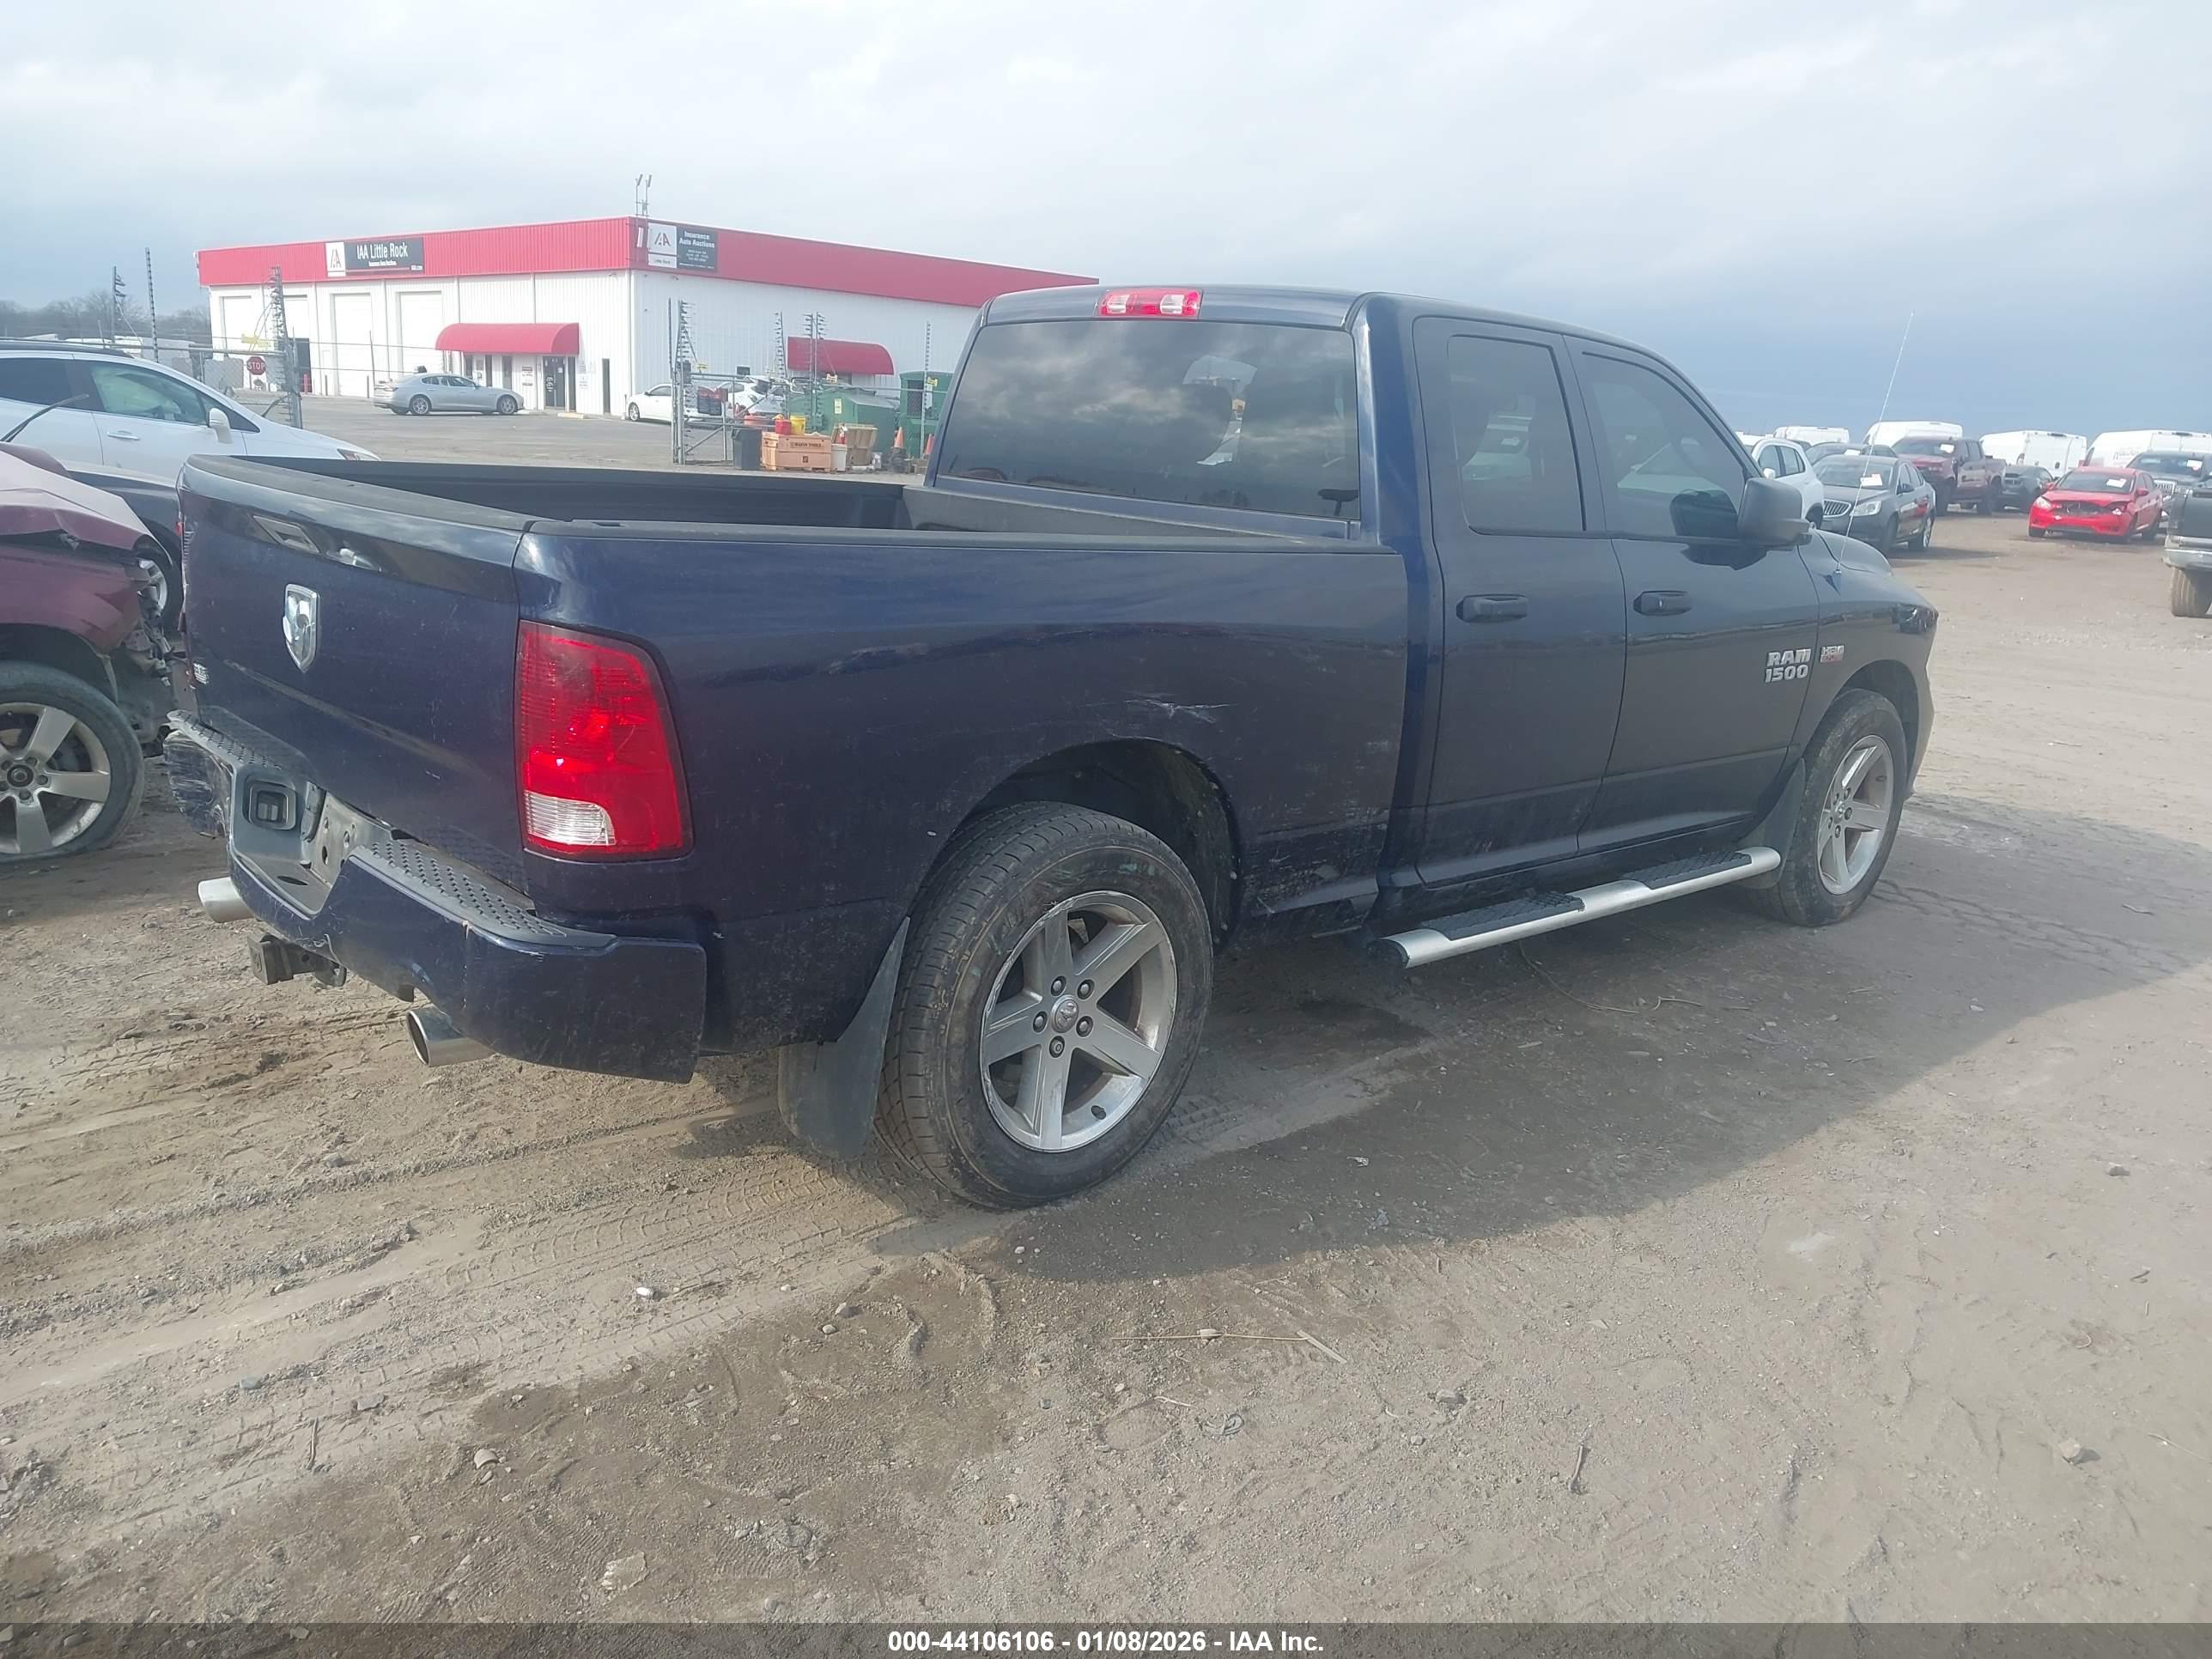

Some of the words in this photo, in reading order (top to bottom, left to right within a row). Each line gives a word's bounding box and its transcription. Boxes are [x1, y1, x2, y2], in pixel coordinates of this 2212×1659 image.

[684, 231, 710, 240] Insurance
[356, 245, 368, 259] IAA
[369, 244, 388, 259] Little
[389, 242, 408, 258] Rock
[692, 240, 715, 248] Auctions
[247, 362, 265, 370] STOP
[1766, 648, 1812, 667] RAM
[1765, 664, 1808, 683] 1500
